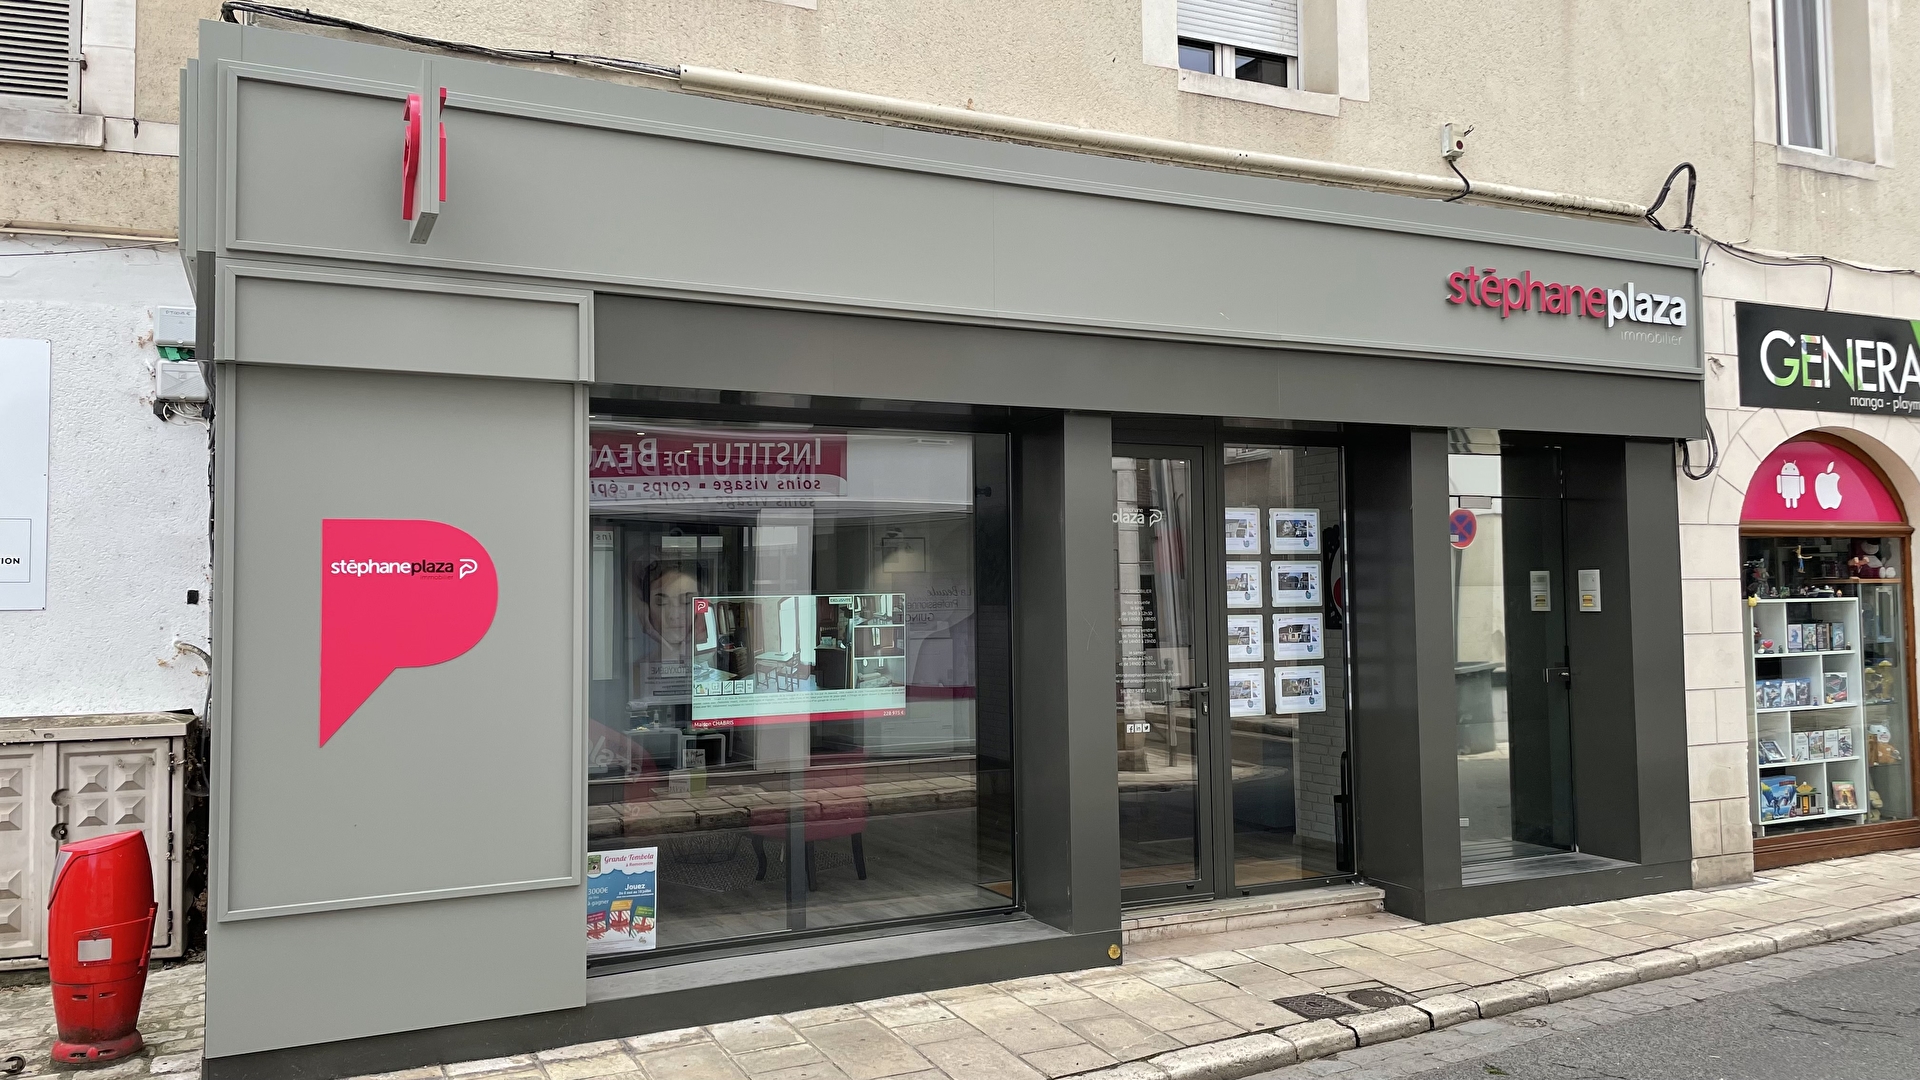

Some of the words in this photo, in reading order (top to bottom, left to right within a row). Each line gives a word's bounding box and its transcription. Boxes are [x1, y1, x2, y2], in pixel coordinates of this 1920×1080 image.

[1620, 330, 1683, 346] immobilier
[1760, 329, 1920, 394] GENERA
[1850, 396, 1884, 411] manga
[0, 557, 20, 565] ION
[604, 855, 627, 864] Grande
[624, 883, 646, 891] Jouez
